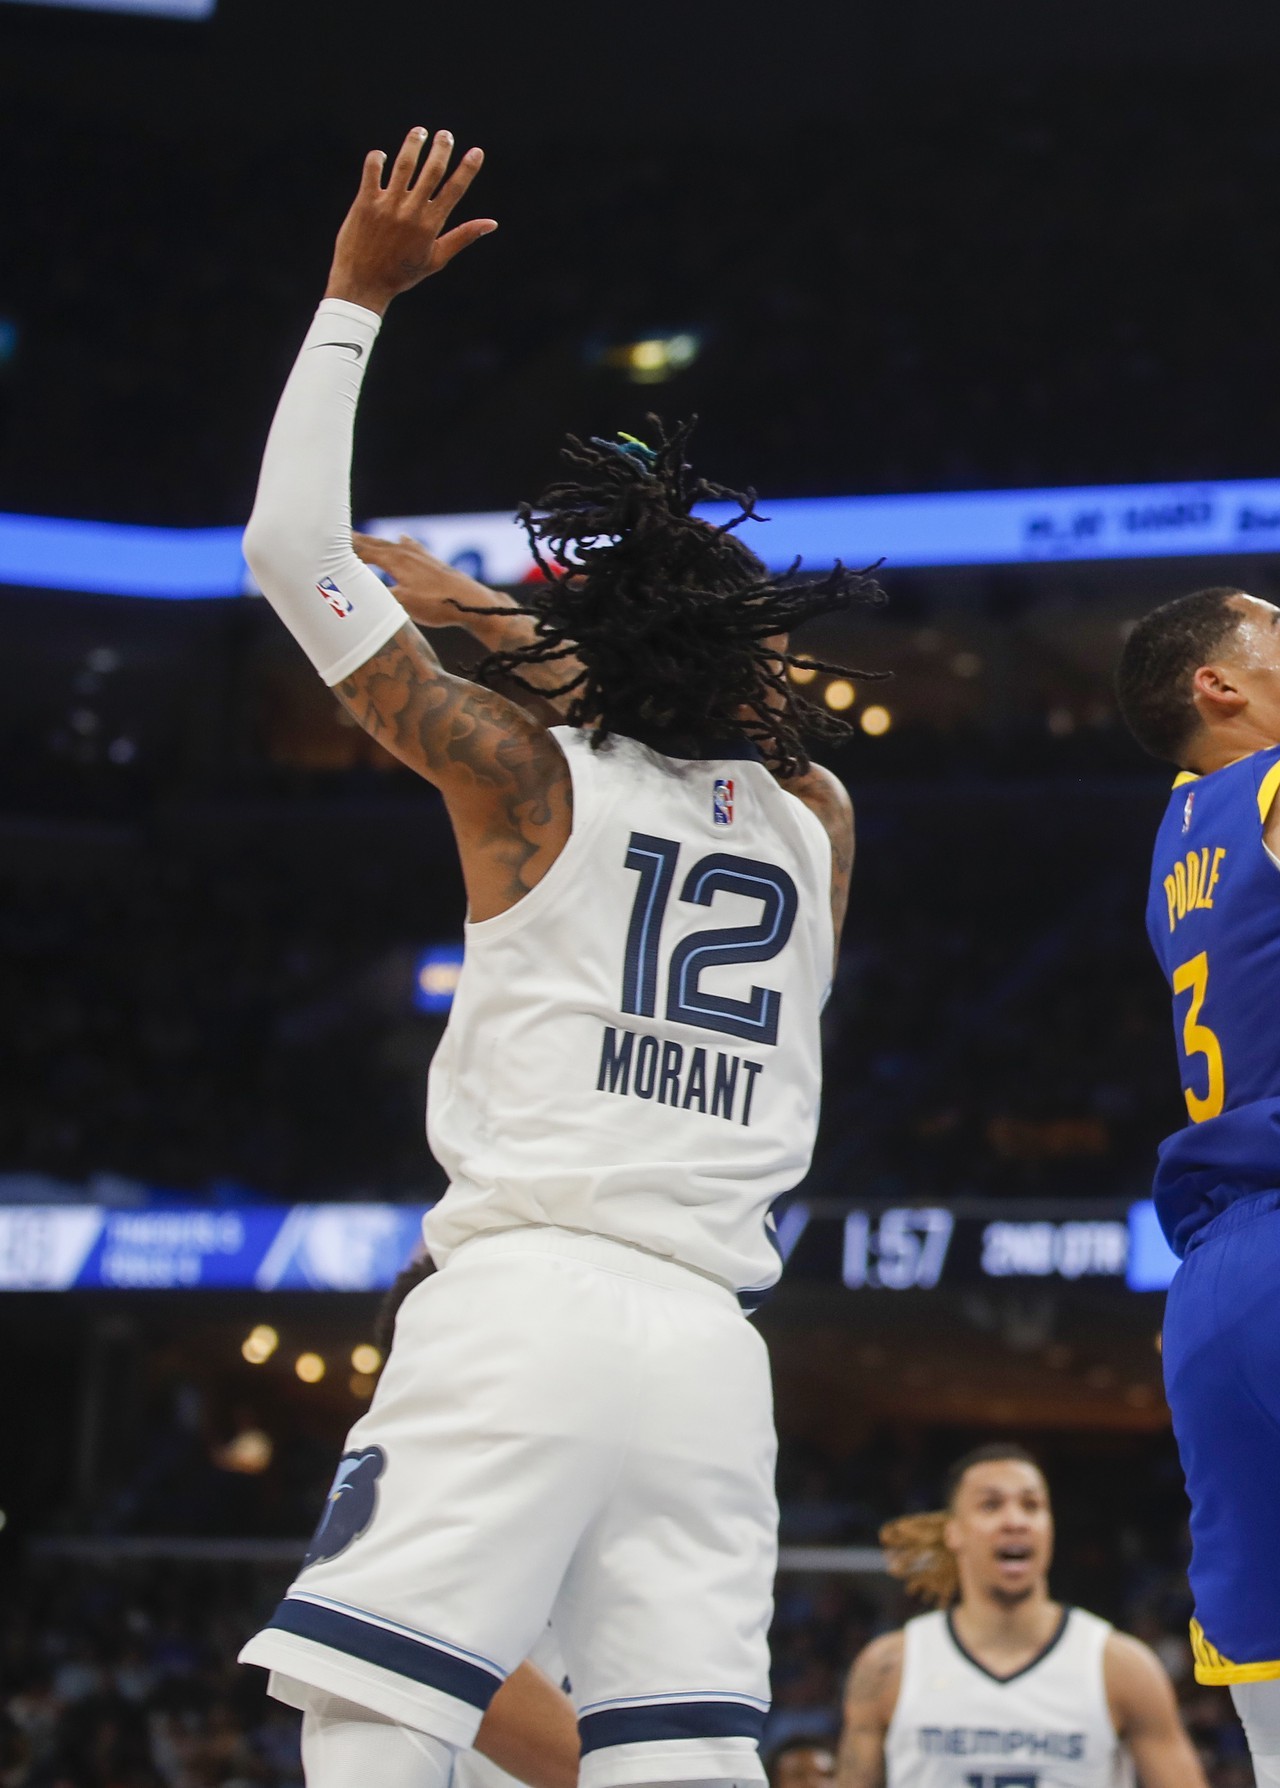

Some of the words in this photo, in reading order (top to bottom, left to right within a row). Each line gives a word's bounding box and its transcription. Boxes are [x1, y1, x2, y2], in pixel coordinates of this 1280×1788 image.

[621, 830, 799, 1047] 12
[1163, 846, 1227, 933] POOLE
[596, 1026, 764, 1126] MORANT
[1172, 951, 1226, 1125] 3
[842, 1206, 954, 1291] 1:57
